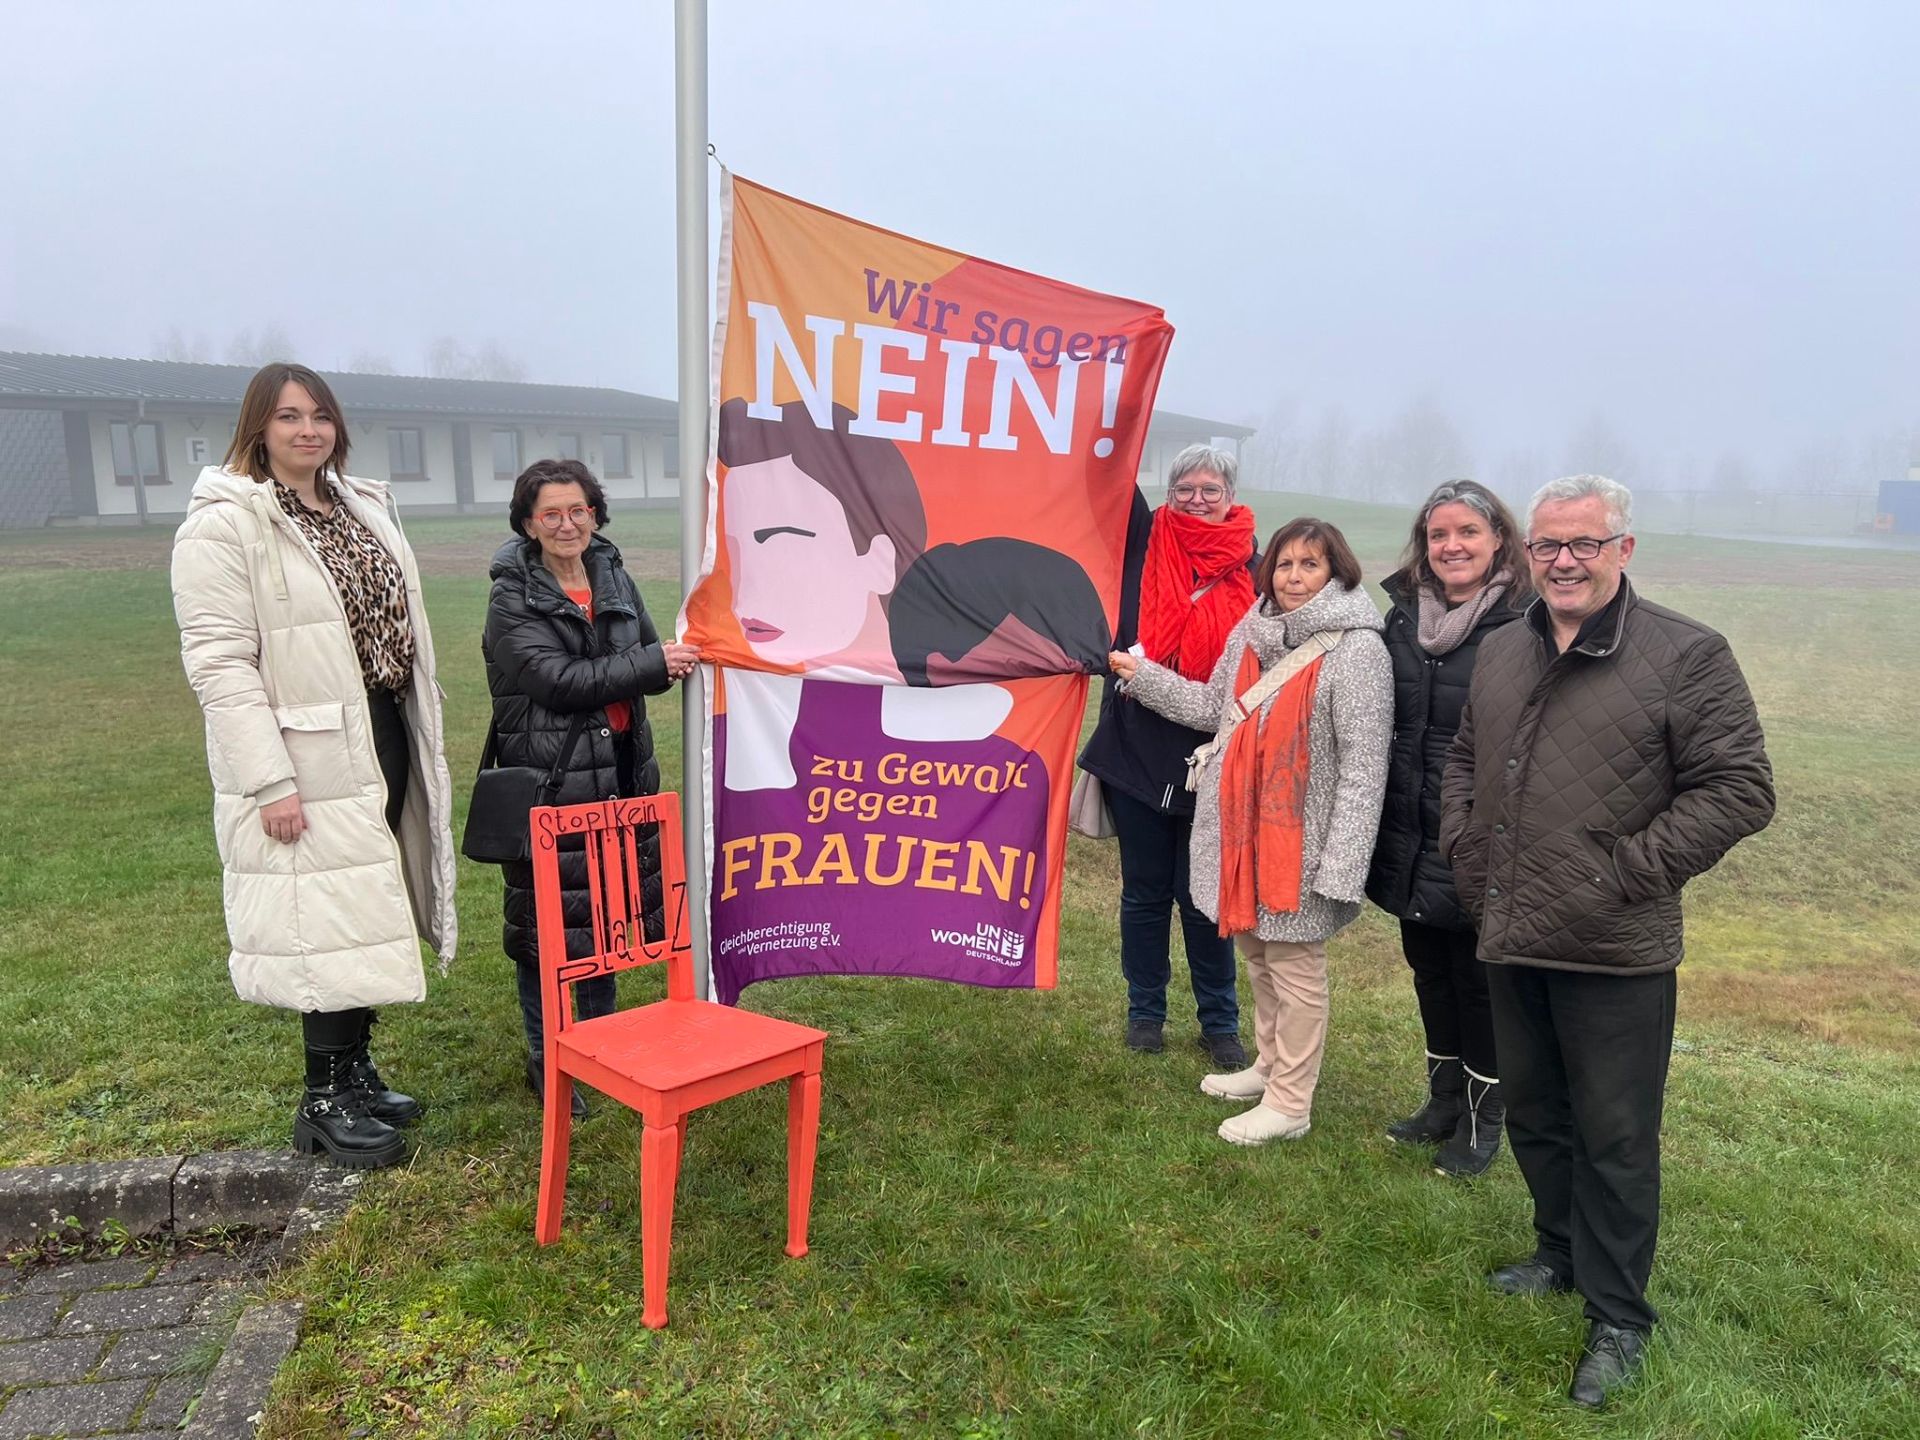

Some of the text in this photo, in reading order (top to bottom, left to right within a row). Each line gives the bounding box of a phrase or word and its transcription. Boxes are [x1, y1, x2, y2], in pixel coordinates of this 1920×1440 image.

[864, 268, 1128, 369] Wir sagen
[746, 300, 1126, 459] NEIN!
[192, 440, 205, 462] F
[811, 754, 863, 783] zu
[807, 786, 938, 824] gegen
[720, 832, 1036, 911] FRAUEN!
[720, 921, 831, 955] Gleichberechtigung
[746, 936, 818, 956] Vernetzung
[820, 934, 841, 947] e.V.
[930, 928, 999, 953] WOMEN
[976, 922, 1001, 940] UN
[966, 949, 1022, 967] DEUTSCHLAND
